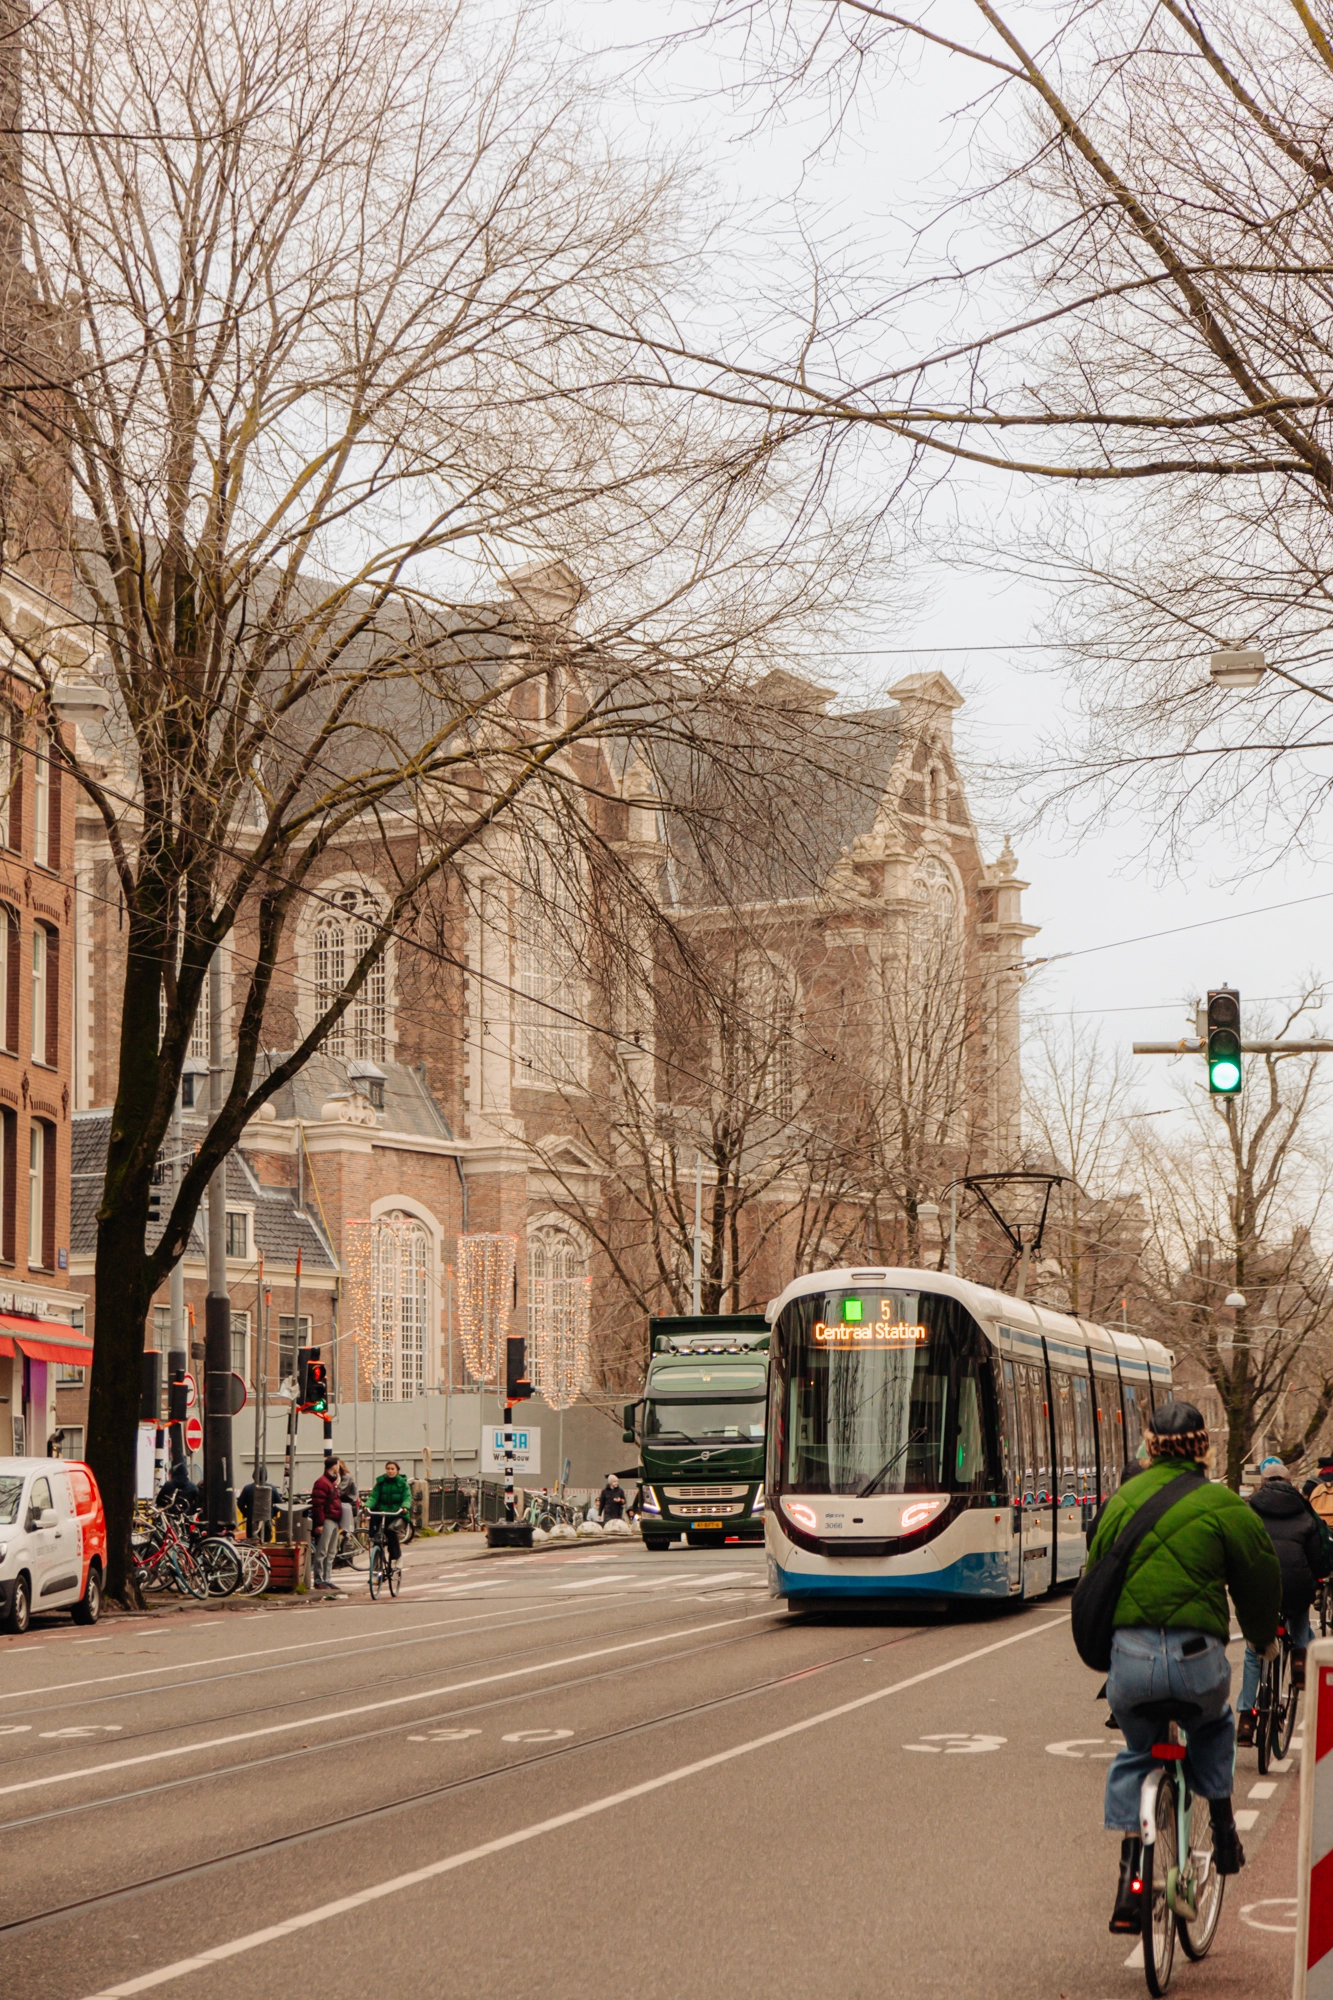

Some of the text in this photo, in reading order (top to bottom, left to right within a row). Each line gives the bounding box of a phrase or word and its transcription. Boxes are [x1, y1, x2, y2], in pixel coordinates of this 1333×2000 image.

[14, 1295, 48, 1315] WESTER
[880, 1299, 891, 1320] 5
[815, 1321, 926, 1340] Centraal Station
[825, 1522, 843, 1530] 3066
